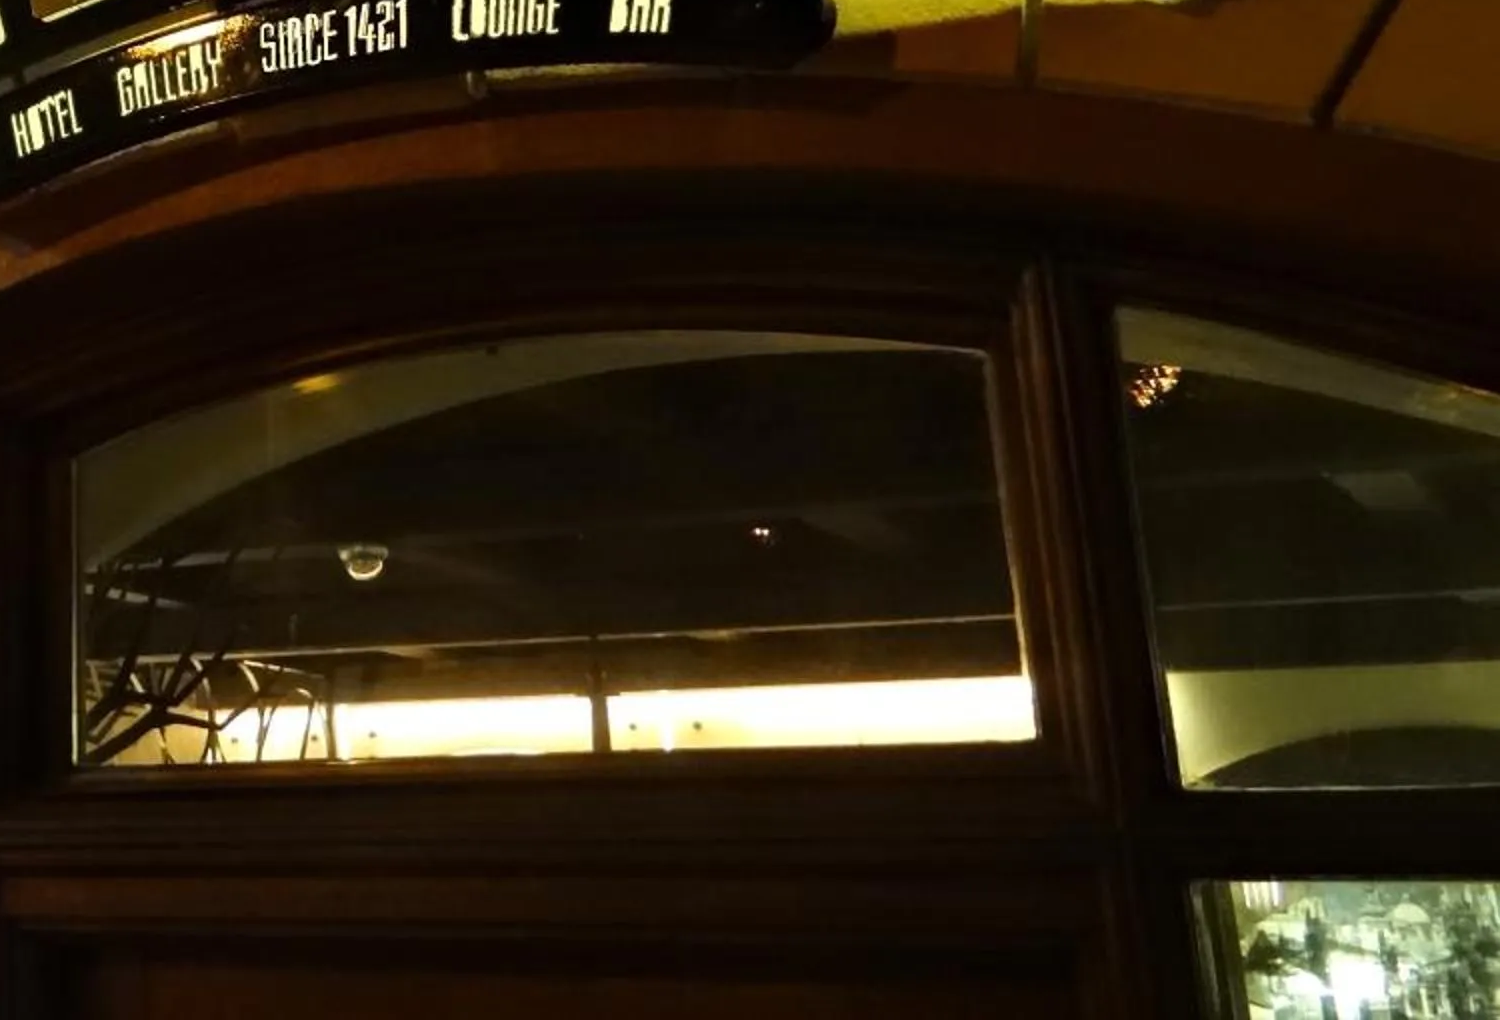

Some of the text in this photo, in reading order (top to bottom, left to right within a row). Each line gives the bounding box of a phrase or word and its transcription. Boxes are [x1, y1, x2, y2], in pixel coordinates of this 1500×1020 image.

[11, 88, 83, 158] HOTEL
[117, 40, 222, 117] GALLERY
[259, 9, 338, 73] SINCE
